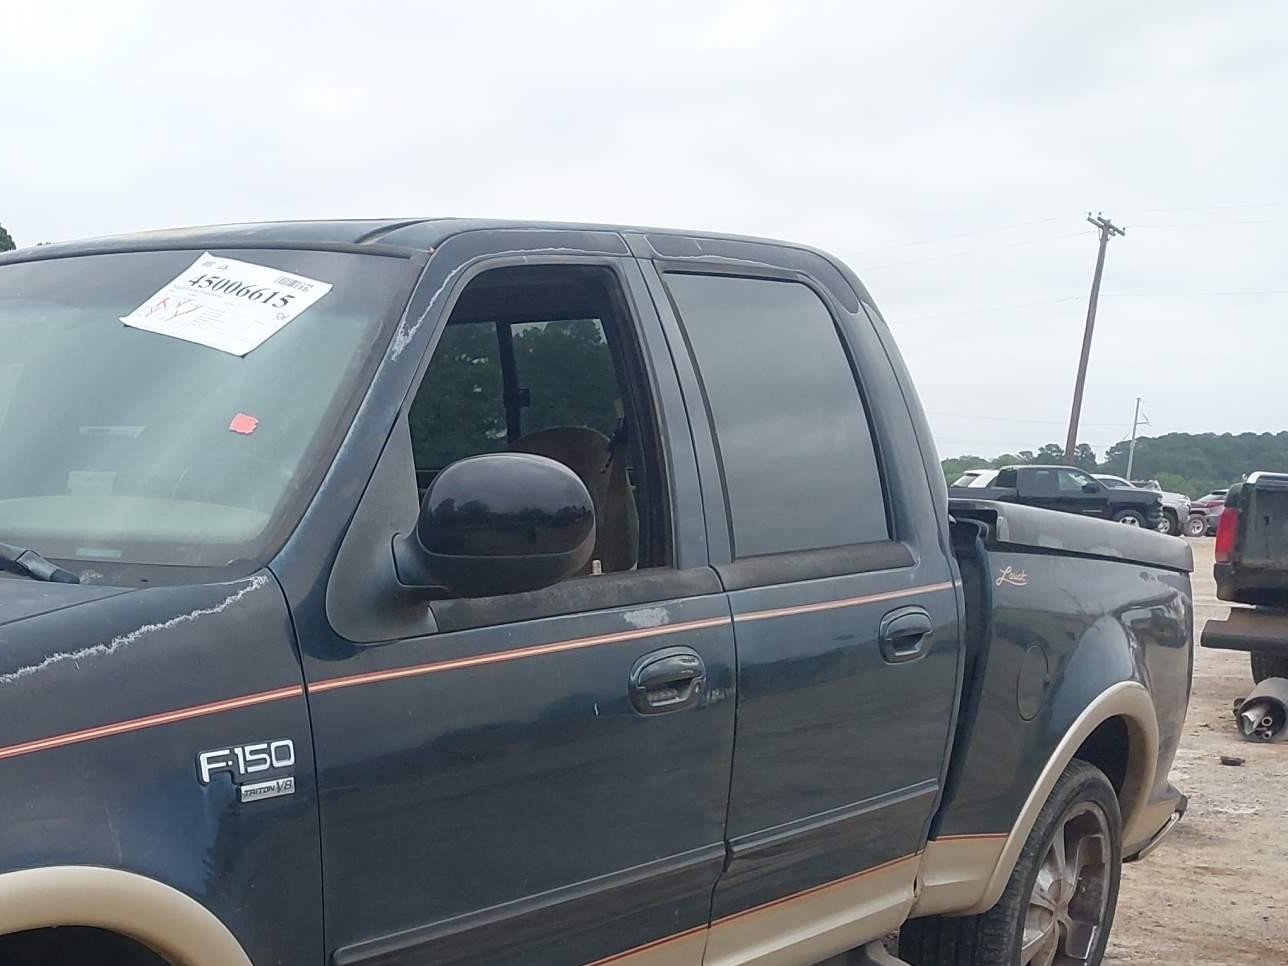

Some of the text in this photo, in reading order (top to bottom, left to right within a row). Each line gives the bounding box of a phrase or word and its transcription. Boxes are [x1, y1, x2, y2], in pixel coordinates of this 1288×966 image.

[188, 273, 296, 309] 45006615
[200, 739, 295, 783] F-150
[243, 779, 293, 798] TRITON V8
